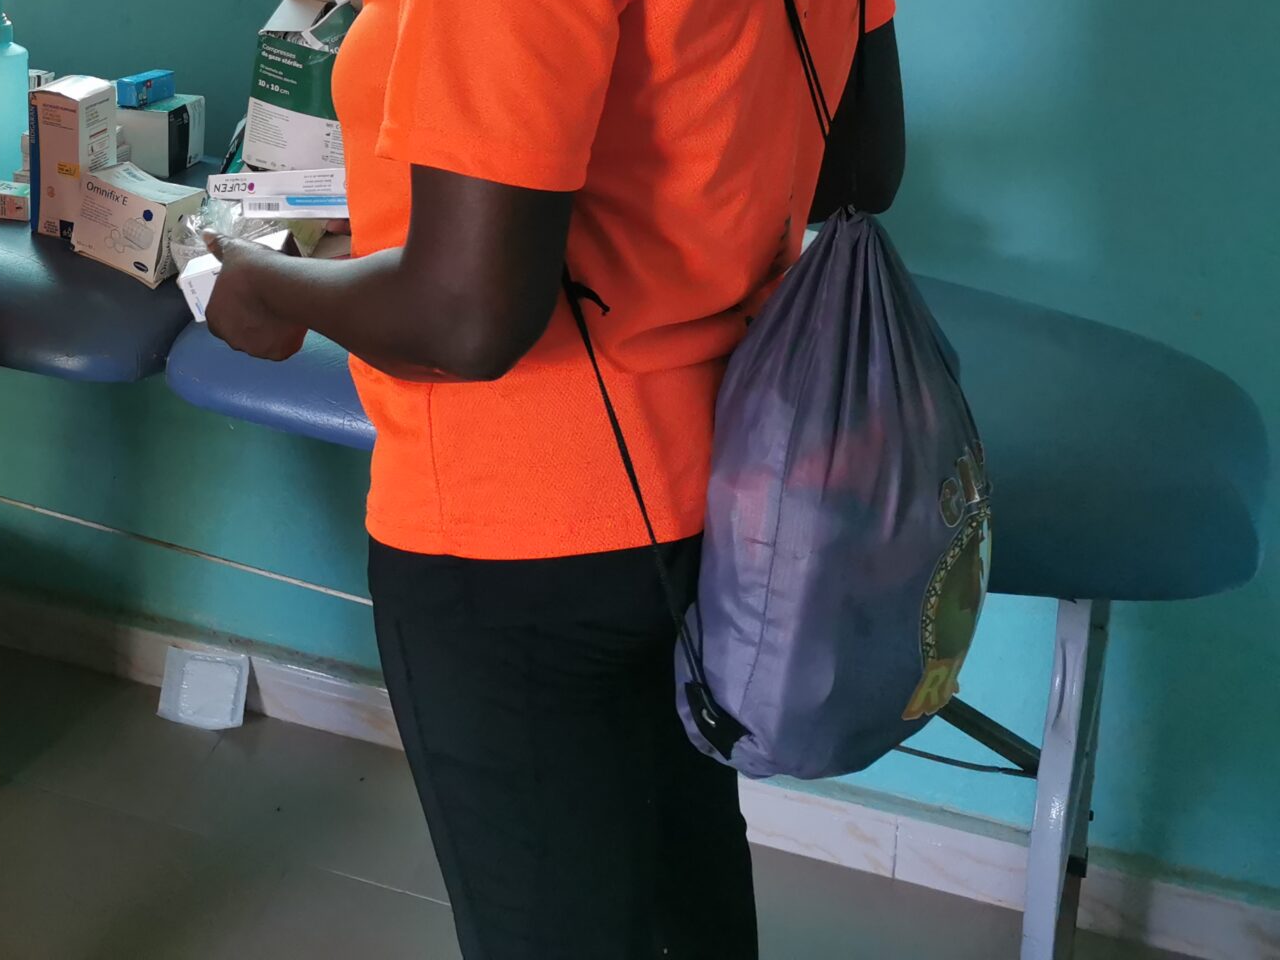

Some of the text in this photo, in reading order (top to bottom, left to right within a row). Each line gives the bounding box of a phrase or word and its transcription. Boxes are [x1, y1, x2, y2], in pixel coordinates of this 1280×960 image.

[262, 43, 296, 58] Compresses
[282, 56, 303, 69] stériles
[258, 79, 266, 88] 10
[270, 84, 280, 92] 10
[86, 181, 129, 206] Omnifix E
